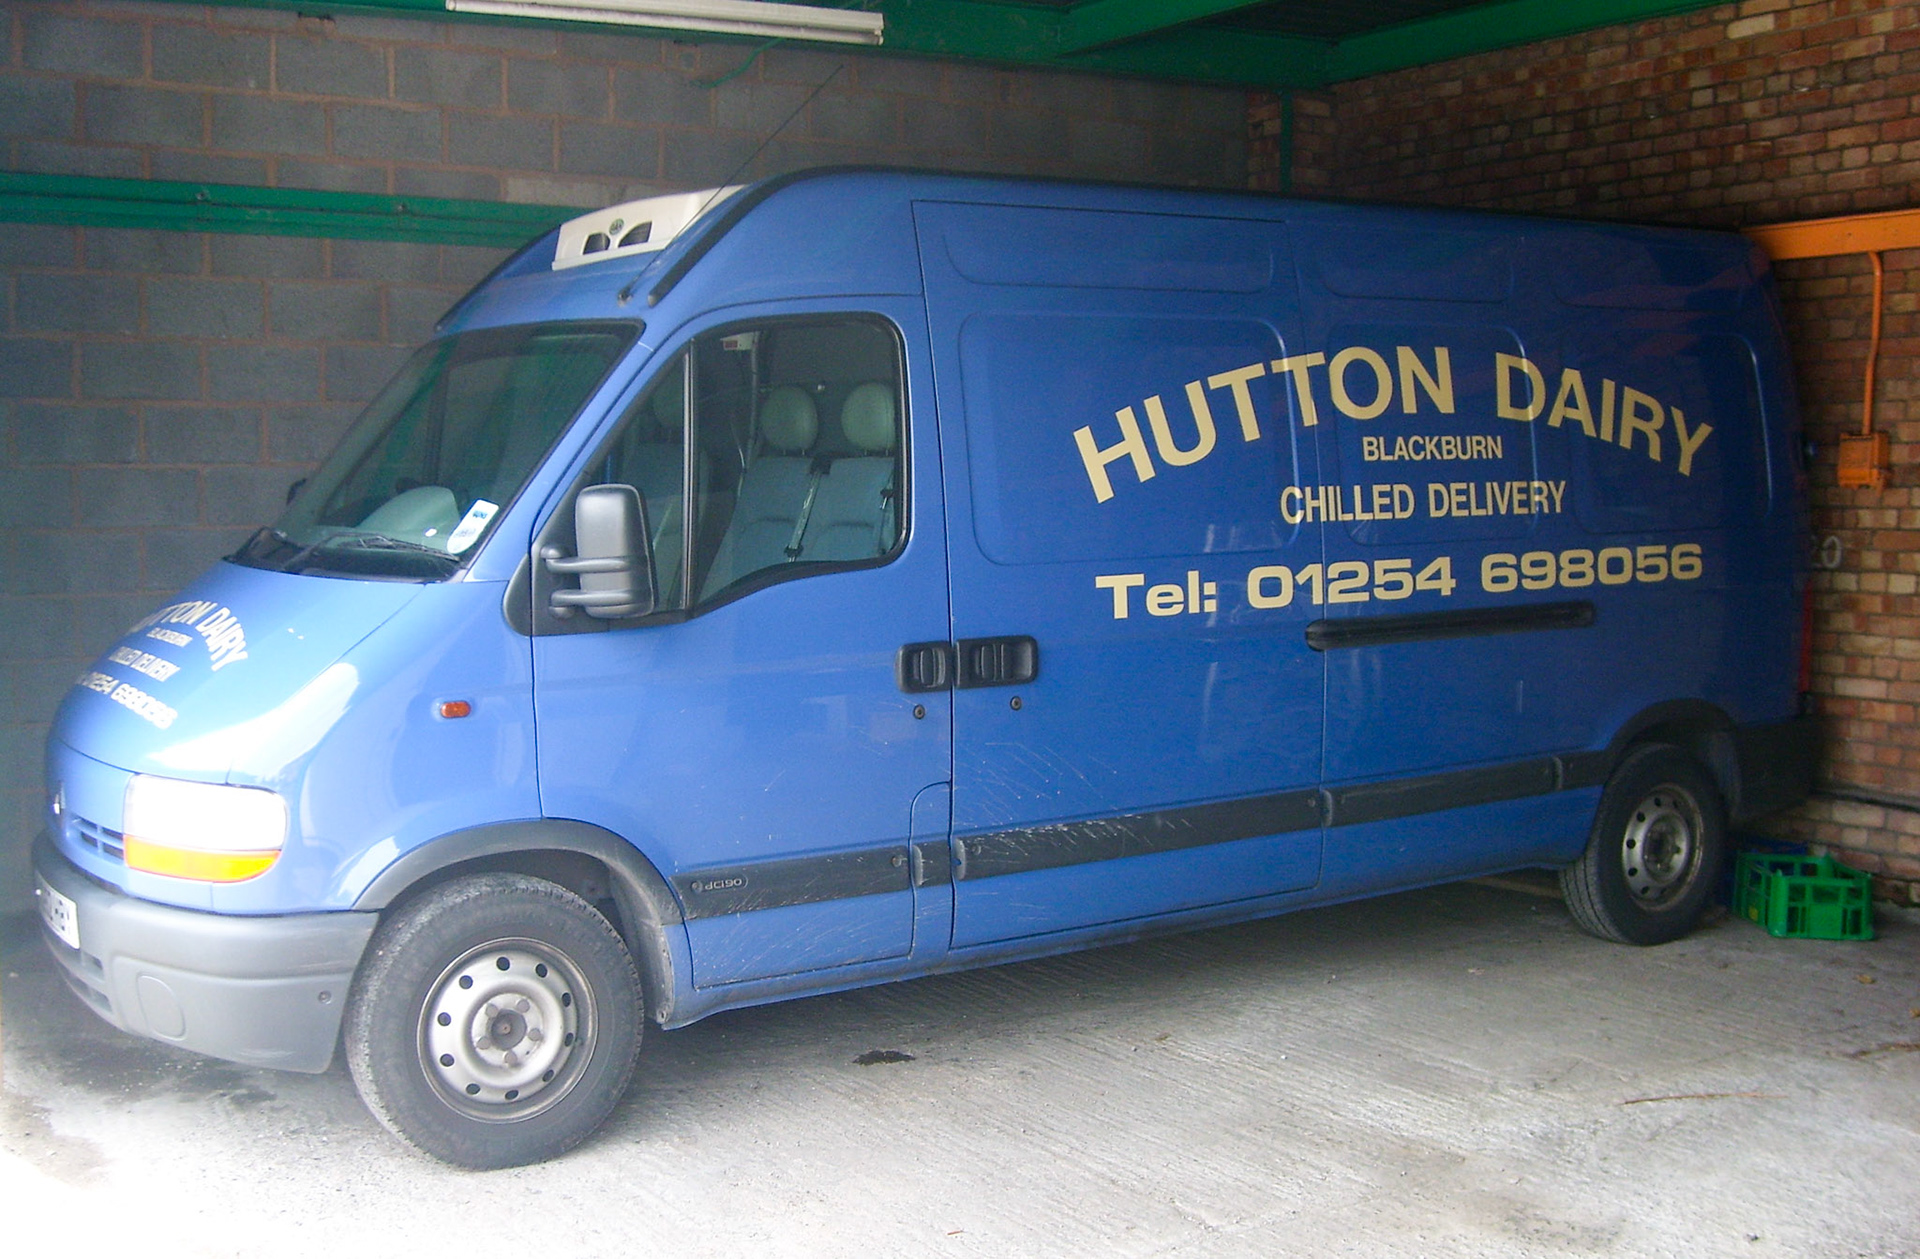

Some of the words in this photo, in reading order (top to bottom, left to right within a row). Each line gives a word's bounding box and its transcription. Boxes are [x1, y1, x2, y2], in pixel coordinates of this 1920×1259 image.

[1073, 345, 1455, 503] HUTTON
[1494, 351, 1713, 477] DAIRY
[1362, 434, 1503, 462] BLACKBURN
[1280, 481, 1415, 525] CHILLED
[1427, 480, 1567, 518] DELIVERY
[1095, 573, 1218, 619] Tel:
[1247, 556, 1456, 609] 01254
[1481, 543, 1703, 592] 698056
[195, 607, 248, 671] DAIRY
